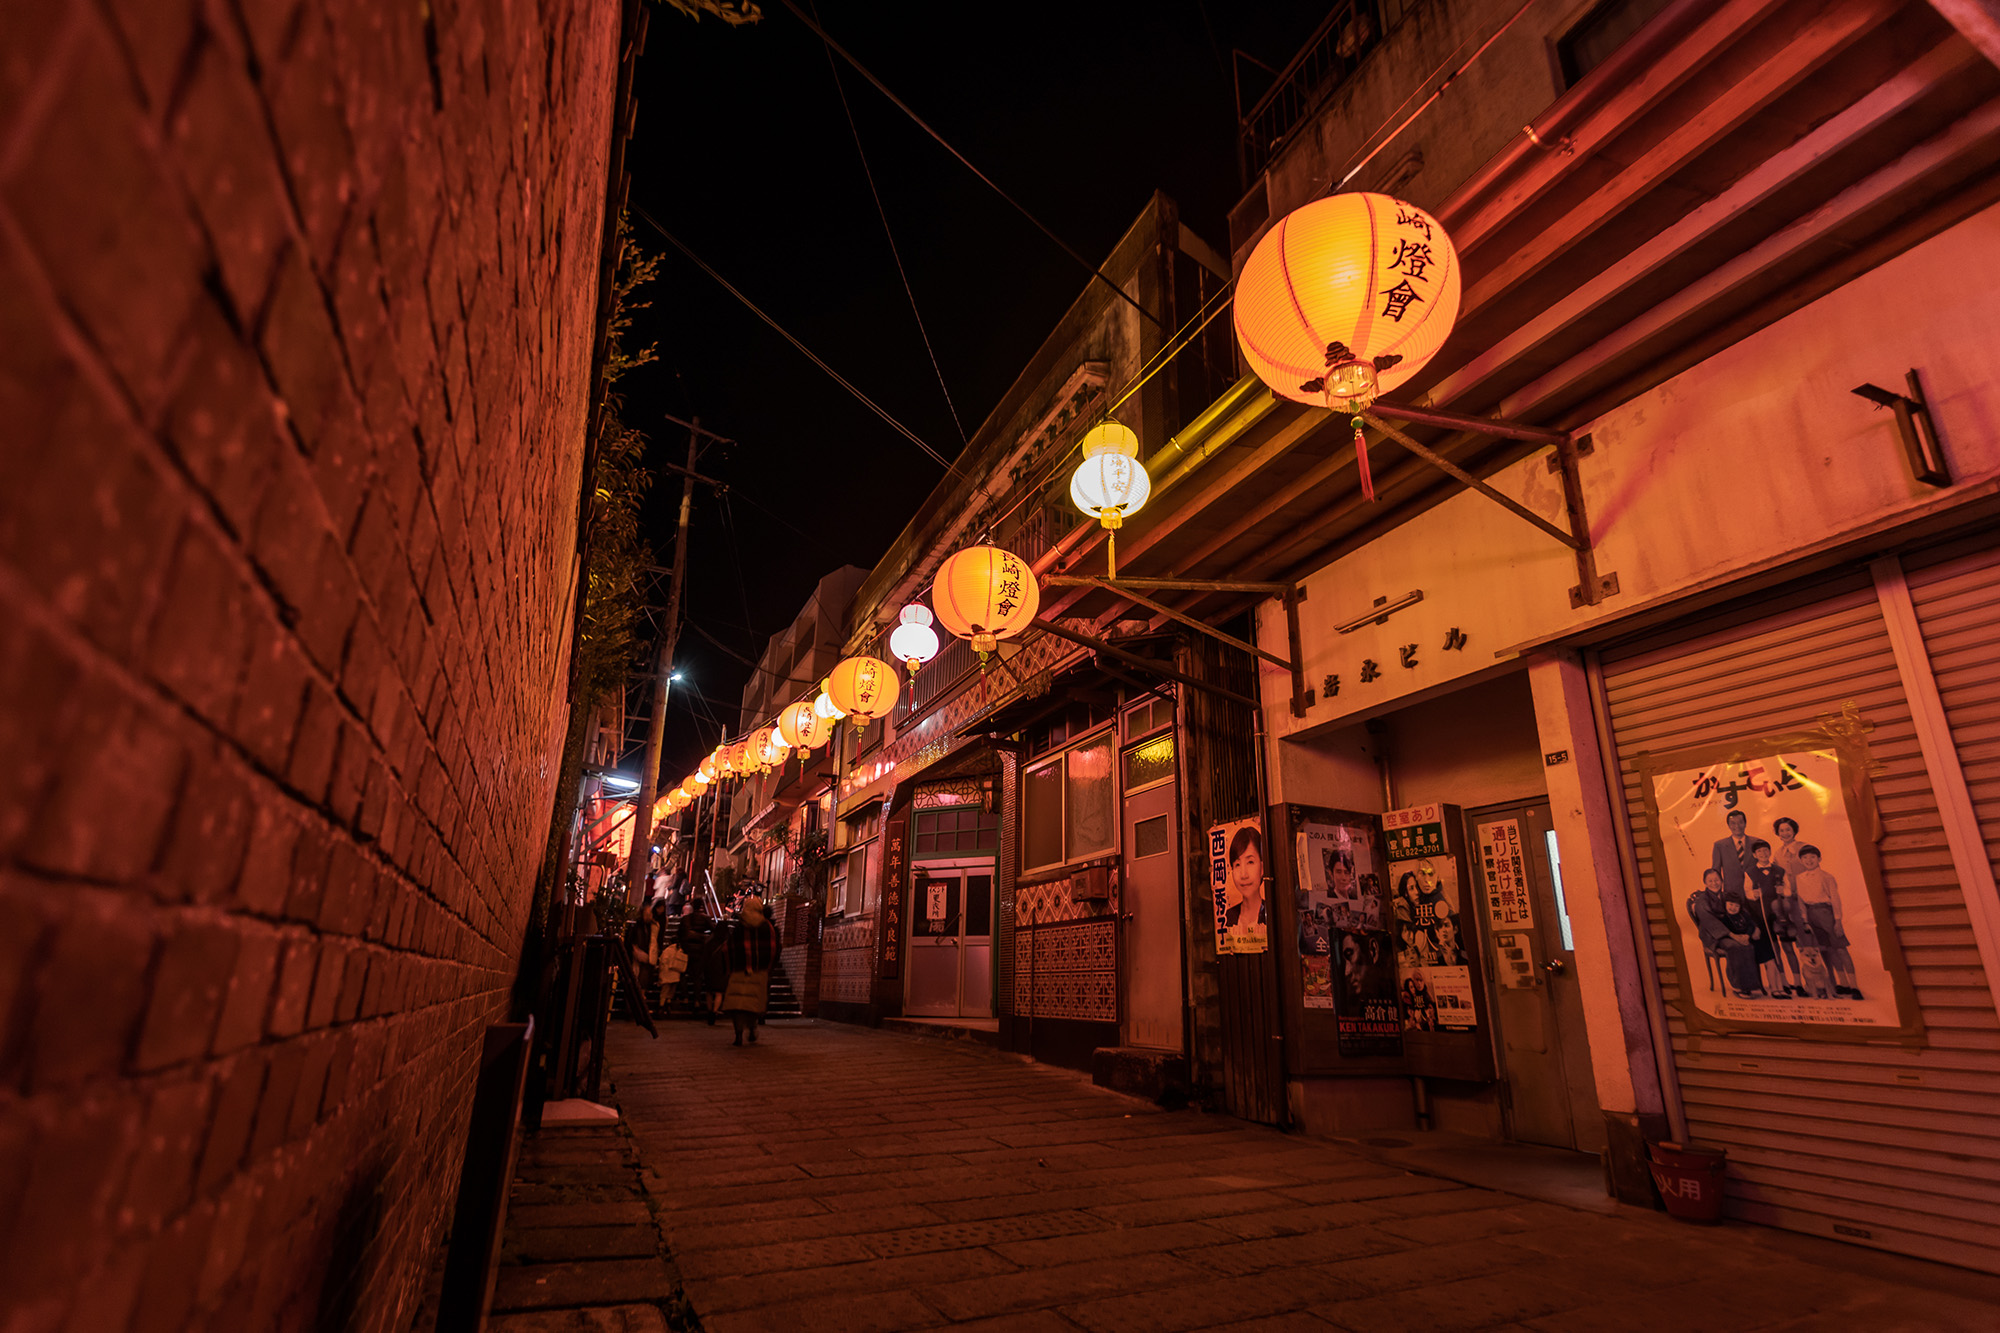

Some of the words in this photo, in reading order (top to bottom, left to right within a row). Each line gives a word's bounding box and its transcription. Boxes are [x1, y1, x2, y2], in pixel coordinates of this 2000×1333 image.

[1378, 199, 1435, 322] 崎燈會
[1548, 752, 1567, 764] 15-5
[1387, 806, 1434, 827] 空室あり
[1390, 850, 1405, 859] TEL
[1405, 844, 1440, 857] 822-3701
[1491, 826, 1518, 923] 通り抜け禁止
[1211, 829, 1227, 945] 西岡秀子
[1483, 846, 1502, 920] 警察官立寄所
[1338, 1022, 1357, 1033] KEN
[1356, 1022, 1400, 1033] TAKAKURA
